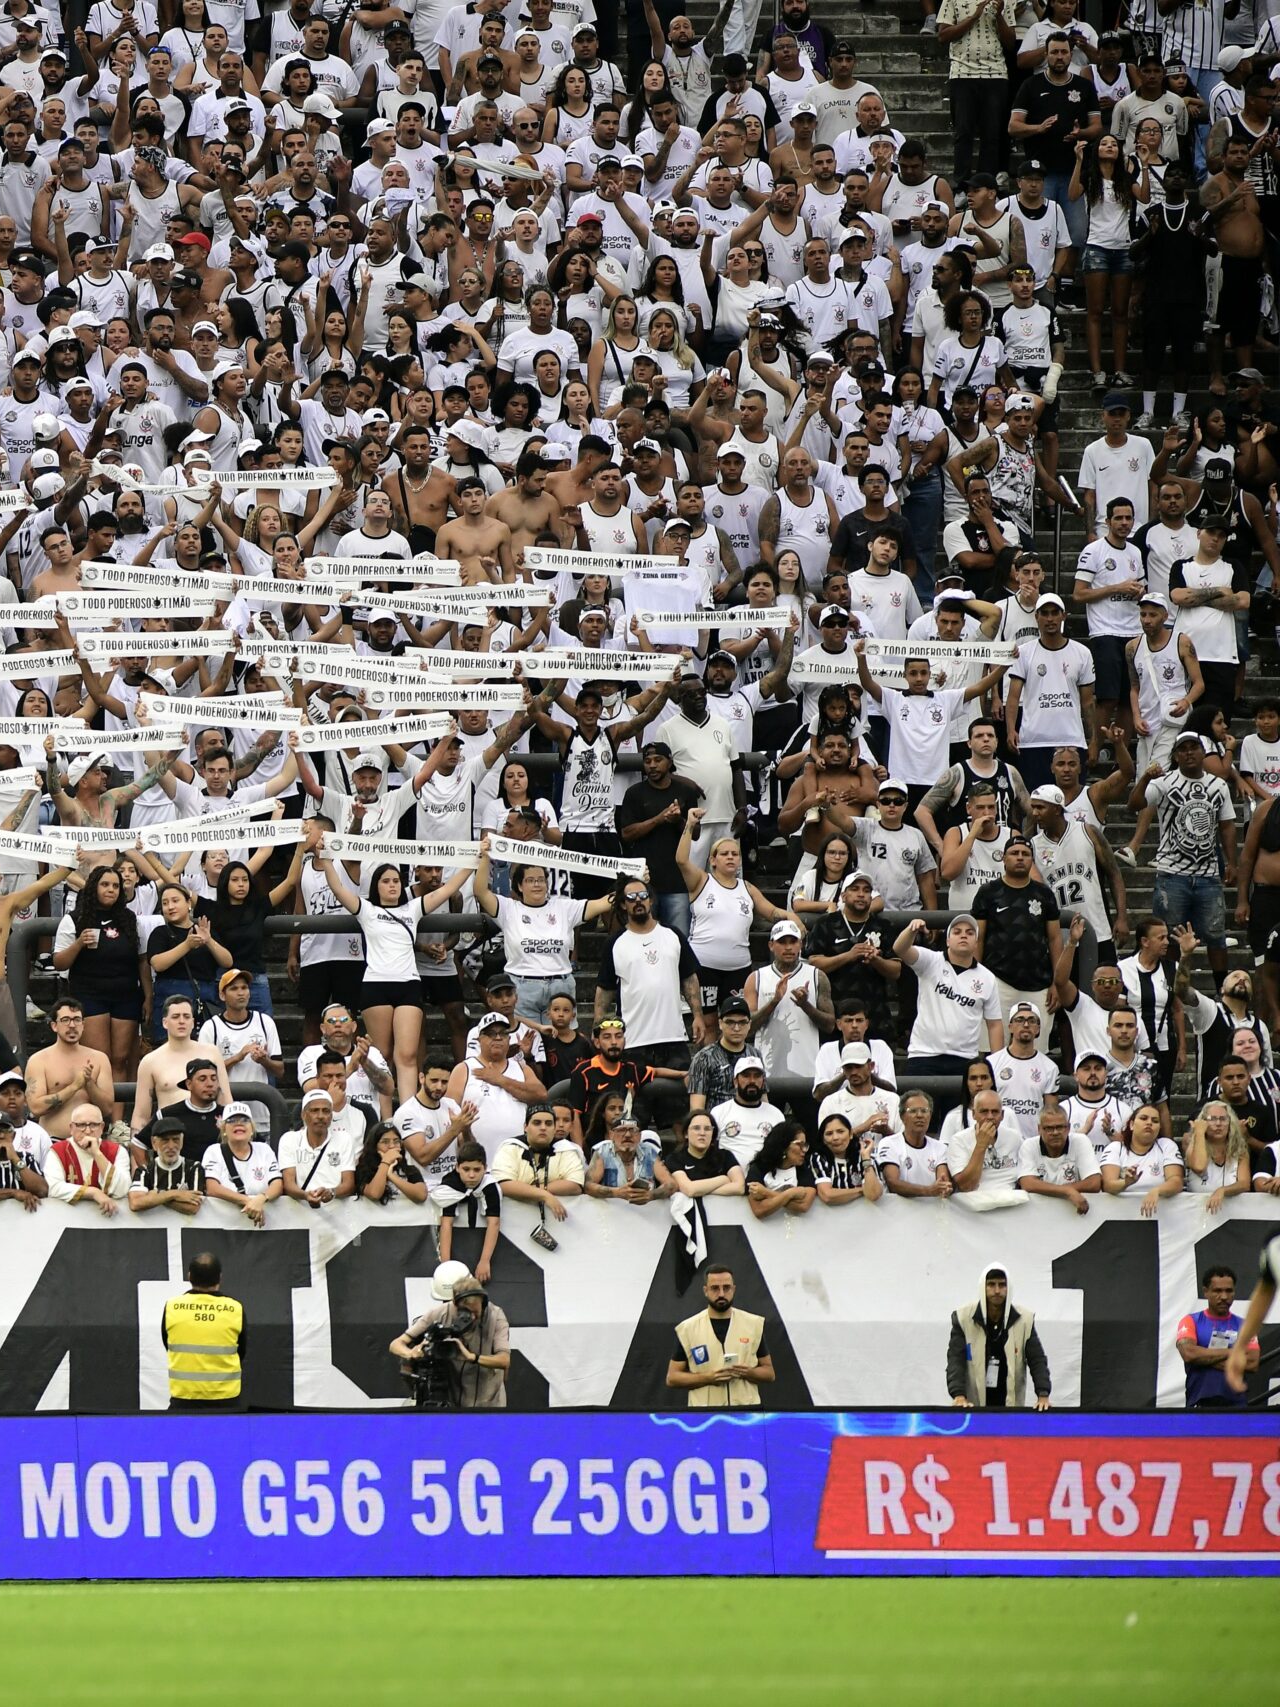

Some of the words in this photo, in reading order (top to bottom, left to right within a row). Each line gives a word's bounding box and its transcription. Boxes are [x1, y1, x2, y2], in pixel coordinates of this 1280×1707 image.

[824, 100, 851, 110] CAMISA
[83, 597, 107, 609] TODO
[108, 597, 153, 609] PODEROSO
[161, 596, 190, 608] TIMÃO
[388, 691, 413, 702] TODO
[415, 691, 460, 702] PODEROSO
[468, 689, 498, 701] TIMÃO
[169, 702, 194, 715] TODO
[195, 705, 240, 719] PODEROSO
[247, 708, 277, 722] TIMÃO
[319, 728, 344, 741] TODO
[344, 723, 390, 738] PODEROSO
[397, 718, 427, 733] TIMÃO
[572, 780, 610, 798] Camisa
[578, 794, 610, 812] Doze
[164, 831, 190, 844] TODO
[191, 828, 238, 842] PODEROSO
[245, 824, 276, 838] TIMÃO
[22, 839, 53, 854] TIMÃO
[871, 845, 888, 860] 12
[550, 868, 571, 896] 12
[1046, 862, 1094, 888] AMISA
[1056, 880, 1086, 906] 12
[520, 938, 564, 946] Esportes
[523, 946, 536, 954] da
[536, 946, 562, 954] Sorte
[934, 982, 976, 1008] Kalunga
[173, 1302, 236, 1313] ORIENTAÇÃO
[194, 1313, 216, 1322] 580
[20, 1461, 217, 1538] MOTO
[243, 1459, 385, 1537] G56
[410, 1458, 504, 1536] 5G
[530, 1457, 771, 1536] 256GB
[864, 1454, 955, 1547] R$
